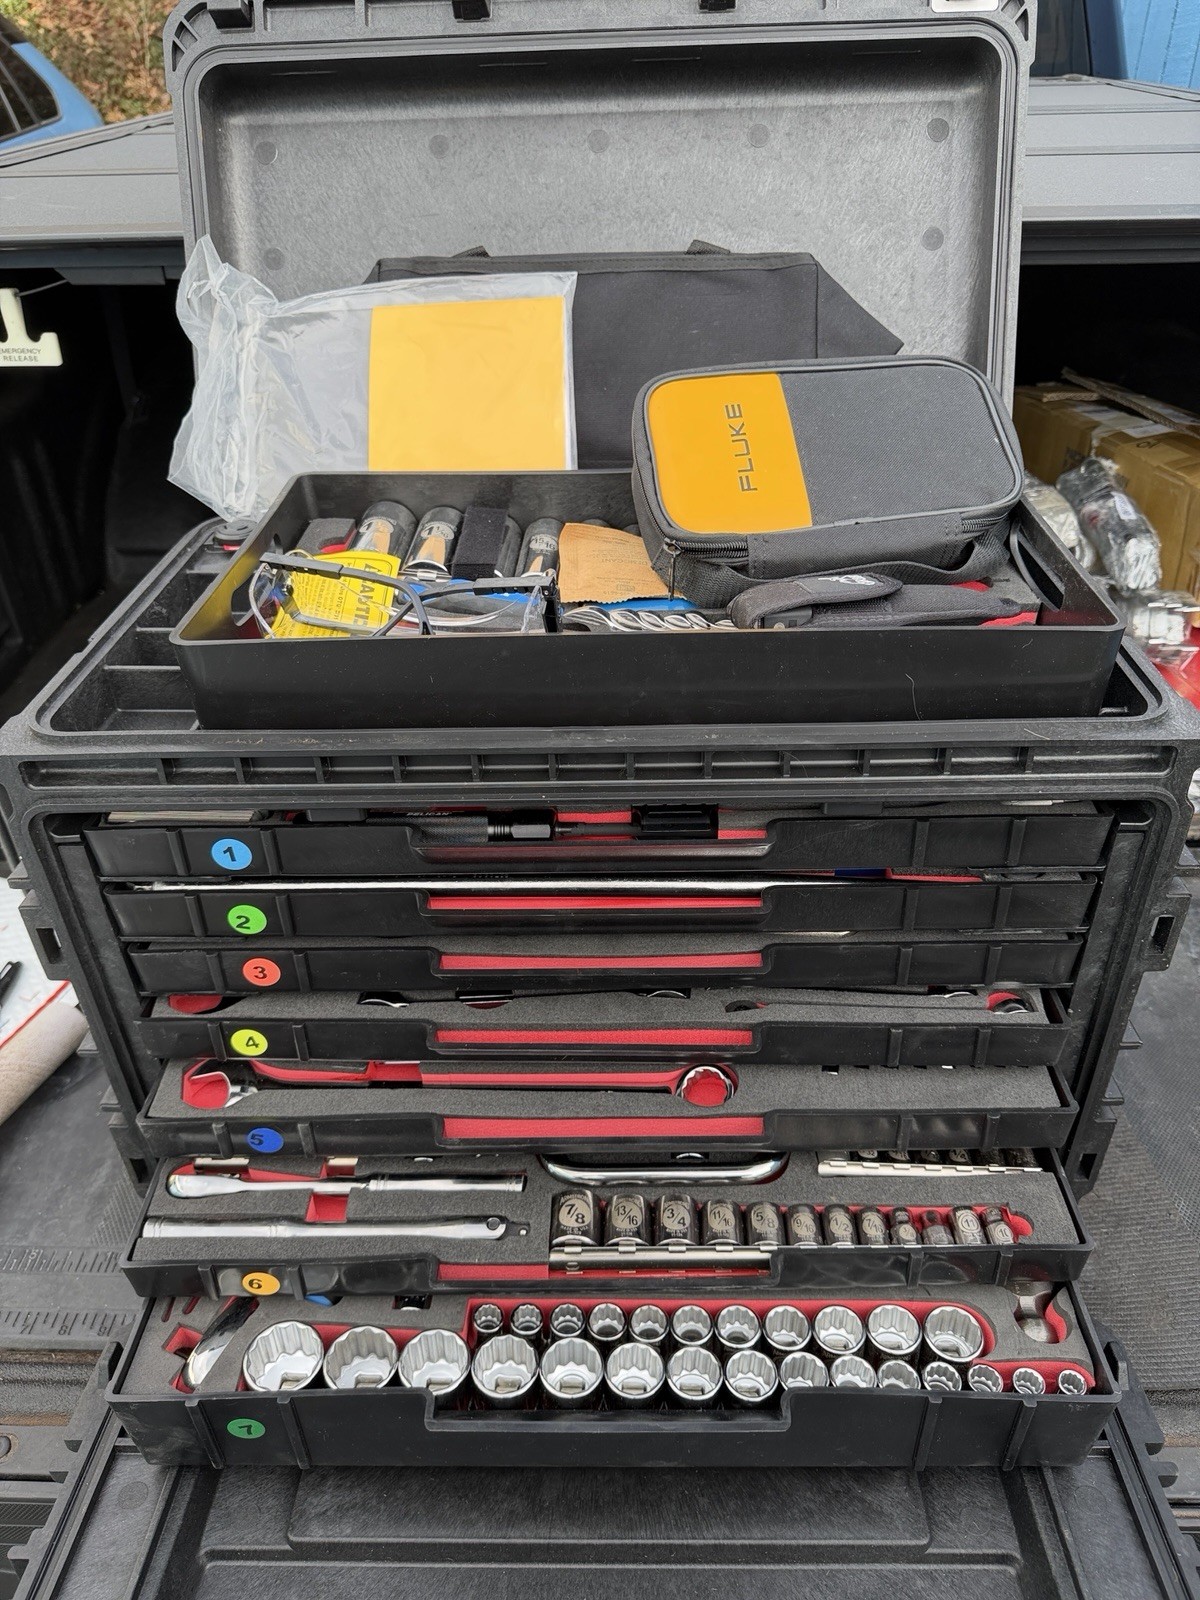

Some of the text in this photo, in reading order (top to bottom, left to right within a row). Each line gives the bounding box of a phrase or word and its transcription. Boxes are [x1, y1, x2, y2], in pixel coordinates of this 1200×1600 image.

[725, 404, 758, 492] FLUKE
[222, 846, 237, 862] 1
[235, 914, 251, 930] 2
[252, 965, 268, 980] 3
[245, 1035, 260, 1049] 4
[249, 1133, 264, 1147] 5
[564, 1202, 587, 1224] 7/8
[613, 1205, 639, 1226] 13/16
[666, 1208, 687, 1227] 3/4
[712, 1210, 733, 1228] 11/16
[755, 1211, 776, 1229] 5/8
[794, 1218, 815, 1233] 9/16
[832, 1216, 850, 1232] 1/2
[865, 1218, 884, 1234] 7/16
[963, 1218, 976, 1229] 11
[248, 1278, 263, 1290] 6
[58, 1324, 69, 1336] 8
[238, 1424, 253, 1436] 7
